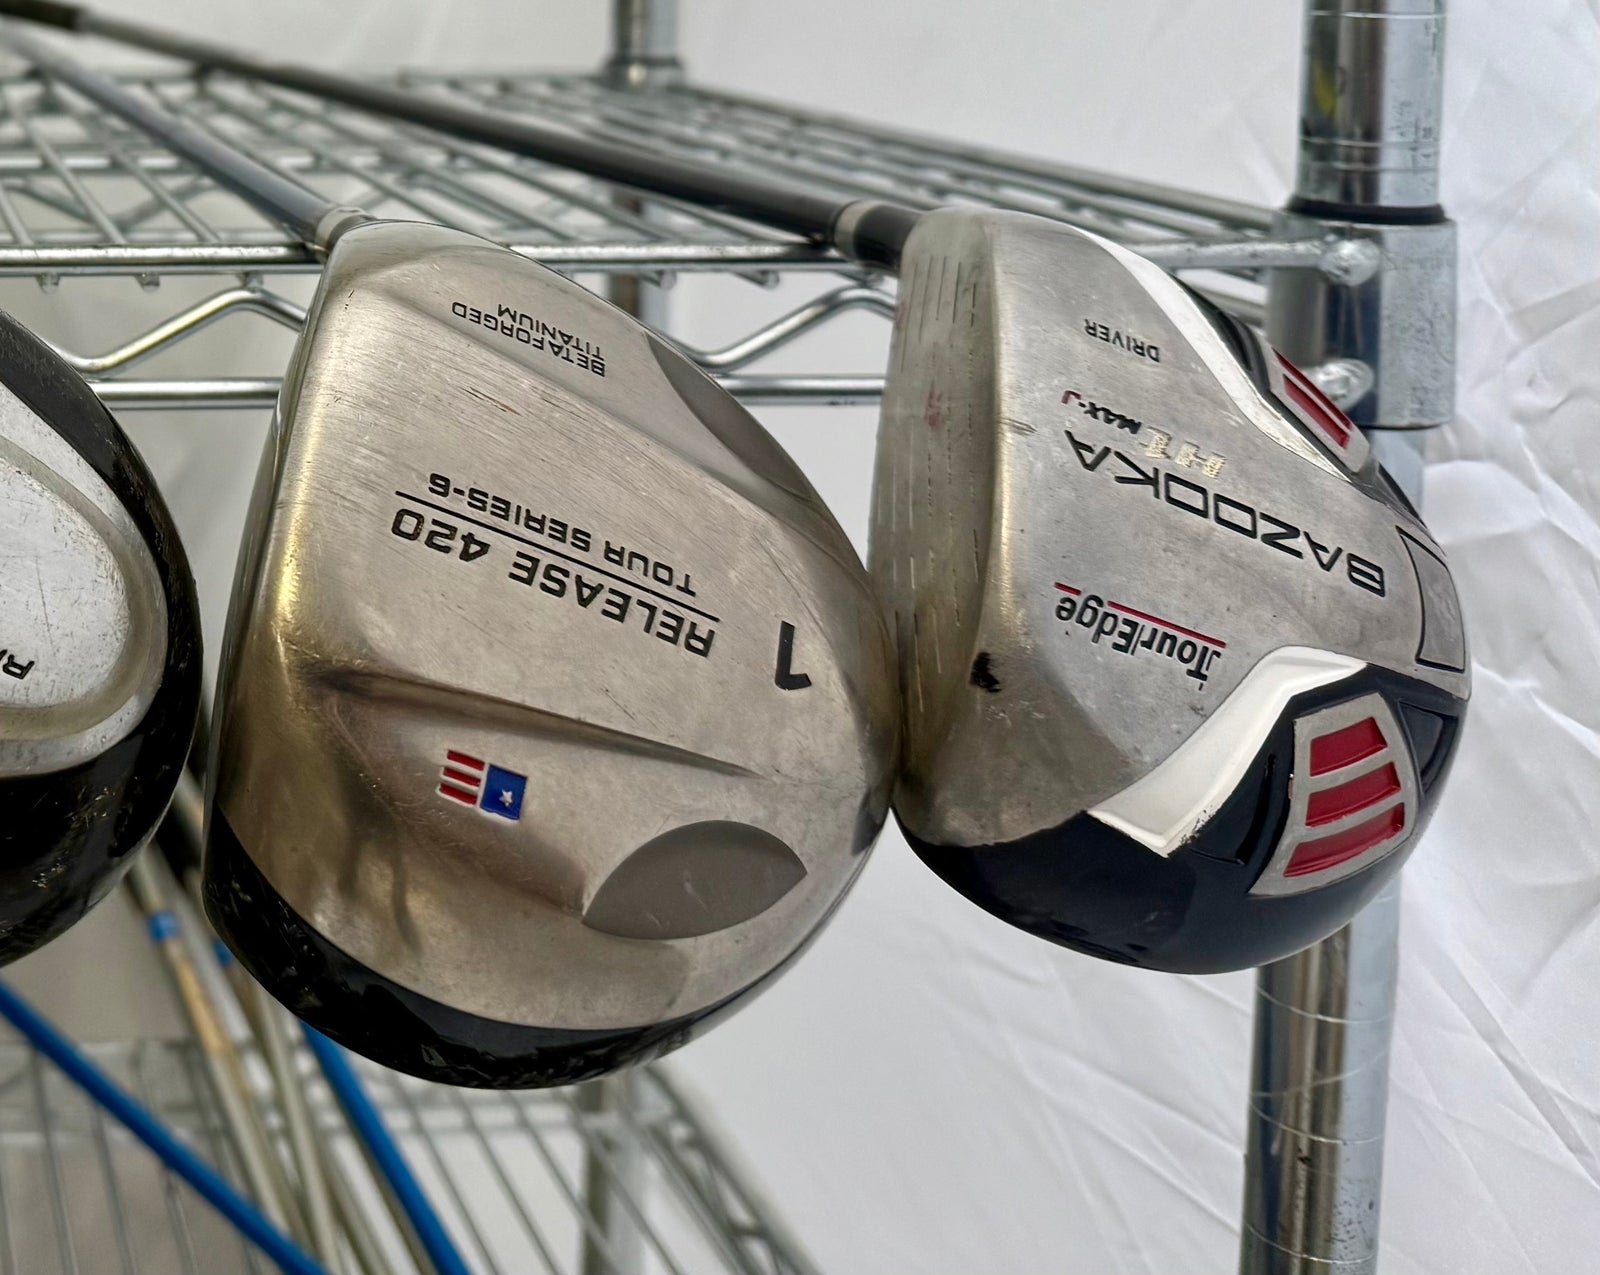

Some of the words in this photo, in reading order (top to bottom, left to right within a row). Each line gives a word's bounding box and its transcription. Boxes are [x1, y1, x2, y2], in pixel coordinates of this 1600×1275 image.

[497, 303, 605, 361] TITANIUM
[1084, 318, 1161, 363] DRIVER
[390, 507, 491, 564] 420
[428, 472, 592, 547] SERIES-6
[1064, 430, 1386, 598] BAZOOKA
[603, 538, 697, 597] TOUR
[508, 550, 717, 659] RELEASE
[774, 620, 812, 692] 1
